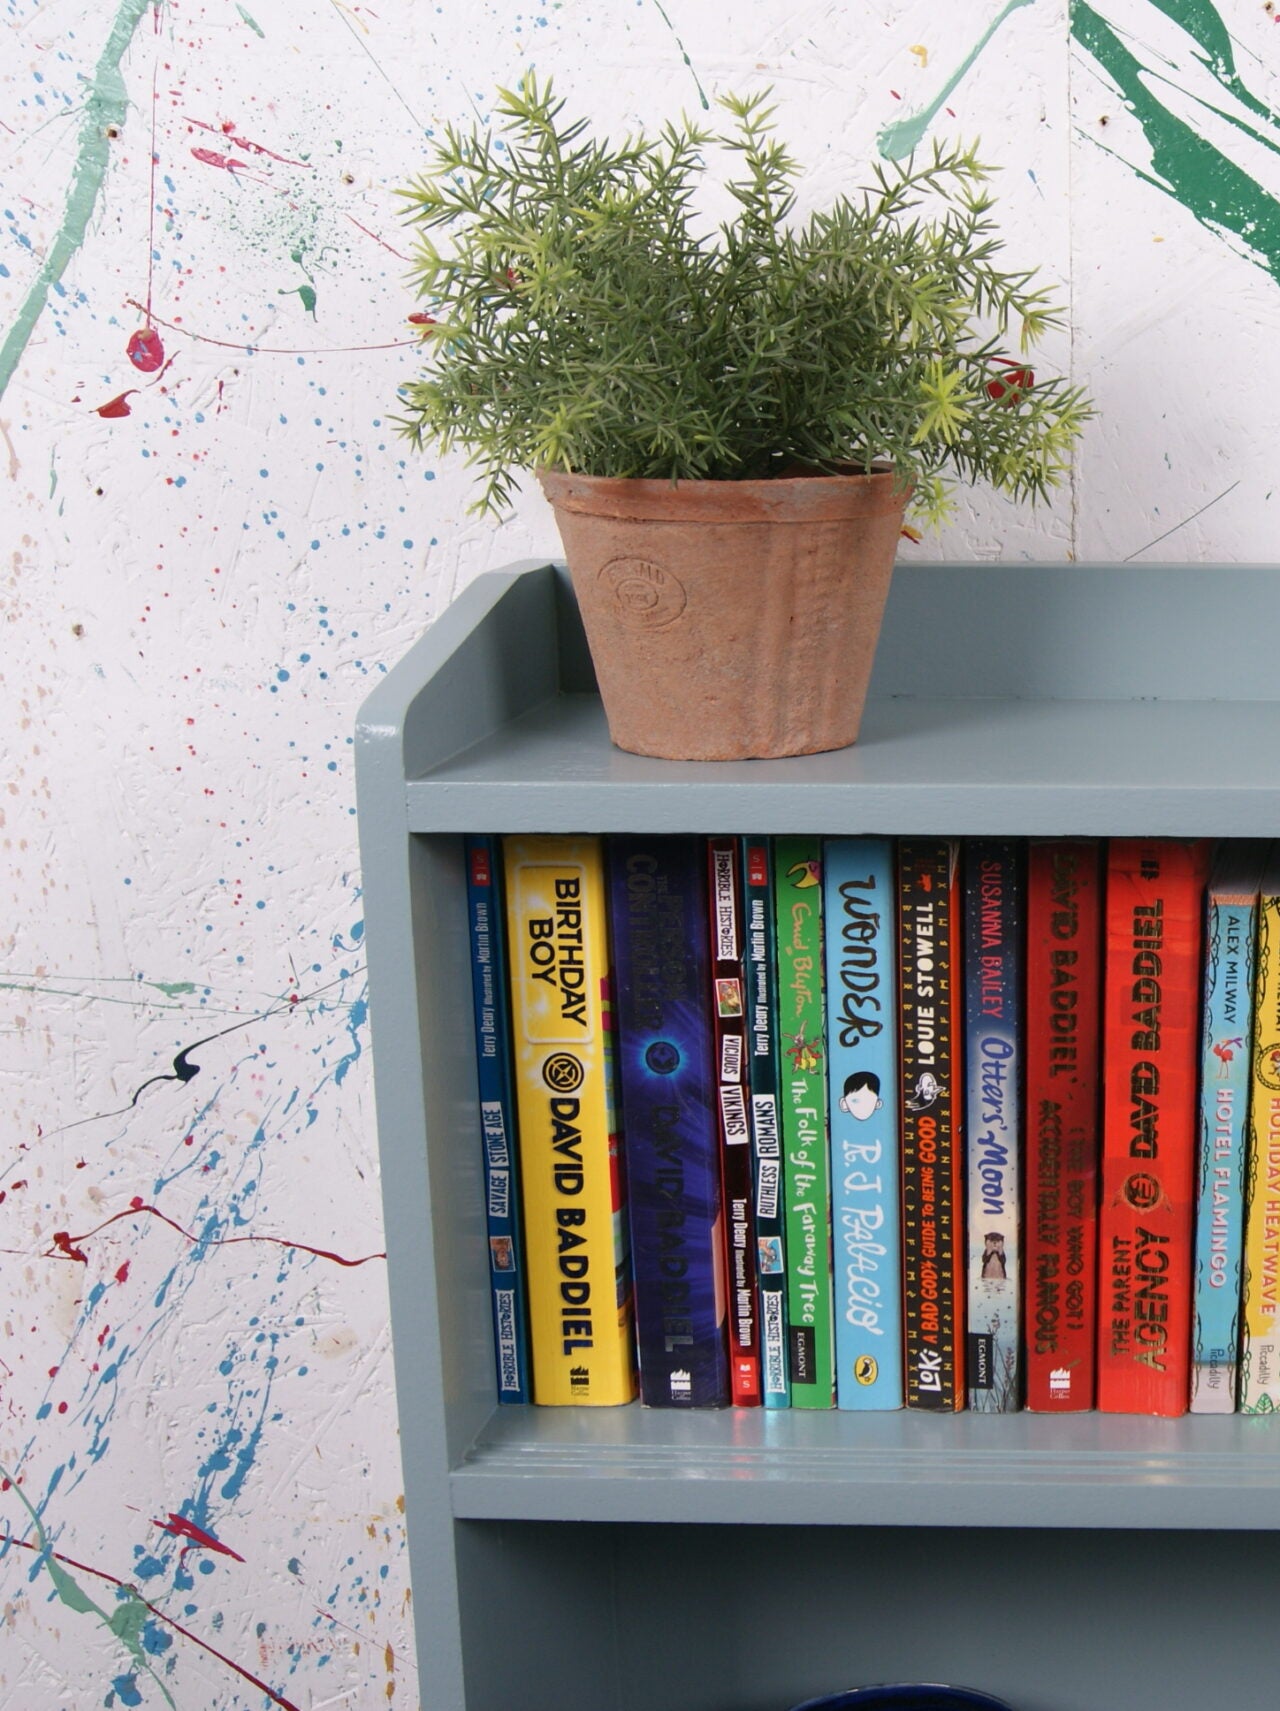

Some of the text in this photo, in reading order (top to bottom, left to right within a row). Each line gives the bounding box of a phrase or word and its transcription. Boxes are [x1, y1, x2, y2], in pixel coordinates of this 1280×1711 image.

[475, 902, 489, 932] Brown
[717, 854, 734, 956] HORRIBLE HISTORIES
[750, 900, 764, 929] Brown
[477, 934, 490, 963] Martin
[528, 917, 557, 986] BOY
[555, 878, 587, 1027] BIRTHDAY
[751, 931, 766, 961] Martin
[980, 860, 1003, 1019] SUSANNA BAILEY
[916, 902, 935, 1065] LOUIE STOWELL
[1049, 853, 1079, 1078] DAVID BADDIEL
[1223, 915, 1240, 1024] ALEX MILWAY
[481, 1007, 495, 1033] Deary
[753, 1005, 768, 1031] Deary
[1129, 899, 1163, 1159] DAVID BADDIEL
[482, 1034, 496, 1057] Terry
[724, 1038, 740, 1075] VICIOUS
[754, 1033, 769, 1056] Terry
[722, 1088, 745, 1136] VIKINGS
[484, 1109, 507, 1214] SAVAGE STONE AGE
[550, 1098, 584, 1195] DAVID
[755, 1101, 777, 1215] RUTHLESS ROMANS
[918, 1116, 937, 1164] GOOD
[921, 1166, 935, 1202] BEING
[977, 1130, 1009, 1215] Moon
[1209, 1088, 1234, 1289] HOTEL FLAMINGO
[732, 1198, 747, 1220] Terry
[790, 1078, 819, 1323] The Folk of the Faraway Tree
[652, 1103, 694, 1352] DAVID BADDIEL
[733, 1222, 748, 1248] Deary
[921, 1220, 937, 1258] GUIDE
[1034, 1099, 1063, 1355] ACCIDENTALLY FAMOUS
[1065, 1223, 1085, 1276] WHO
[556, 1208, 593, 1355] BADDIEL
[737, 1289, 752, 1316] Martin
[1111, 1235, 1131, 1356] THE PARENT
[1133, 1226, 1170, 1372] AGENCY
[499, 1293, 517, 1388] HORRIBLE HISTORIES
[738, 1318, 753, 1346] Brown
[920, 1302, 939, 1332] BAD
[922, 1335, 938, 1344] A
[766, 1295, 782, 1389] HORRIBLE HISTORIES
[797, 1332, 806, 1378] EGMONT
[978, 1338, 987, 1385] EGMONT
[1257, 1344, 1275, 1386] Piccadilly
[1208, 1348, 1225, 1390] Piccadilly
